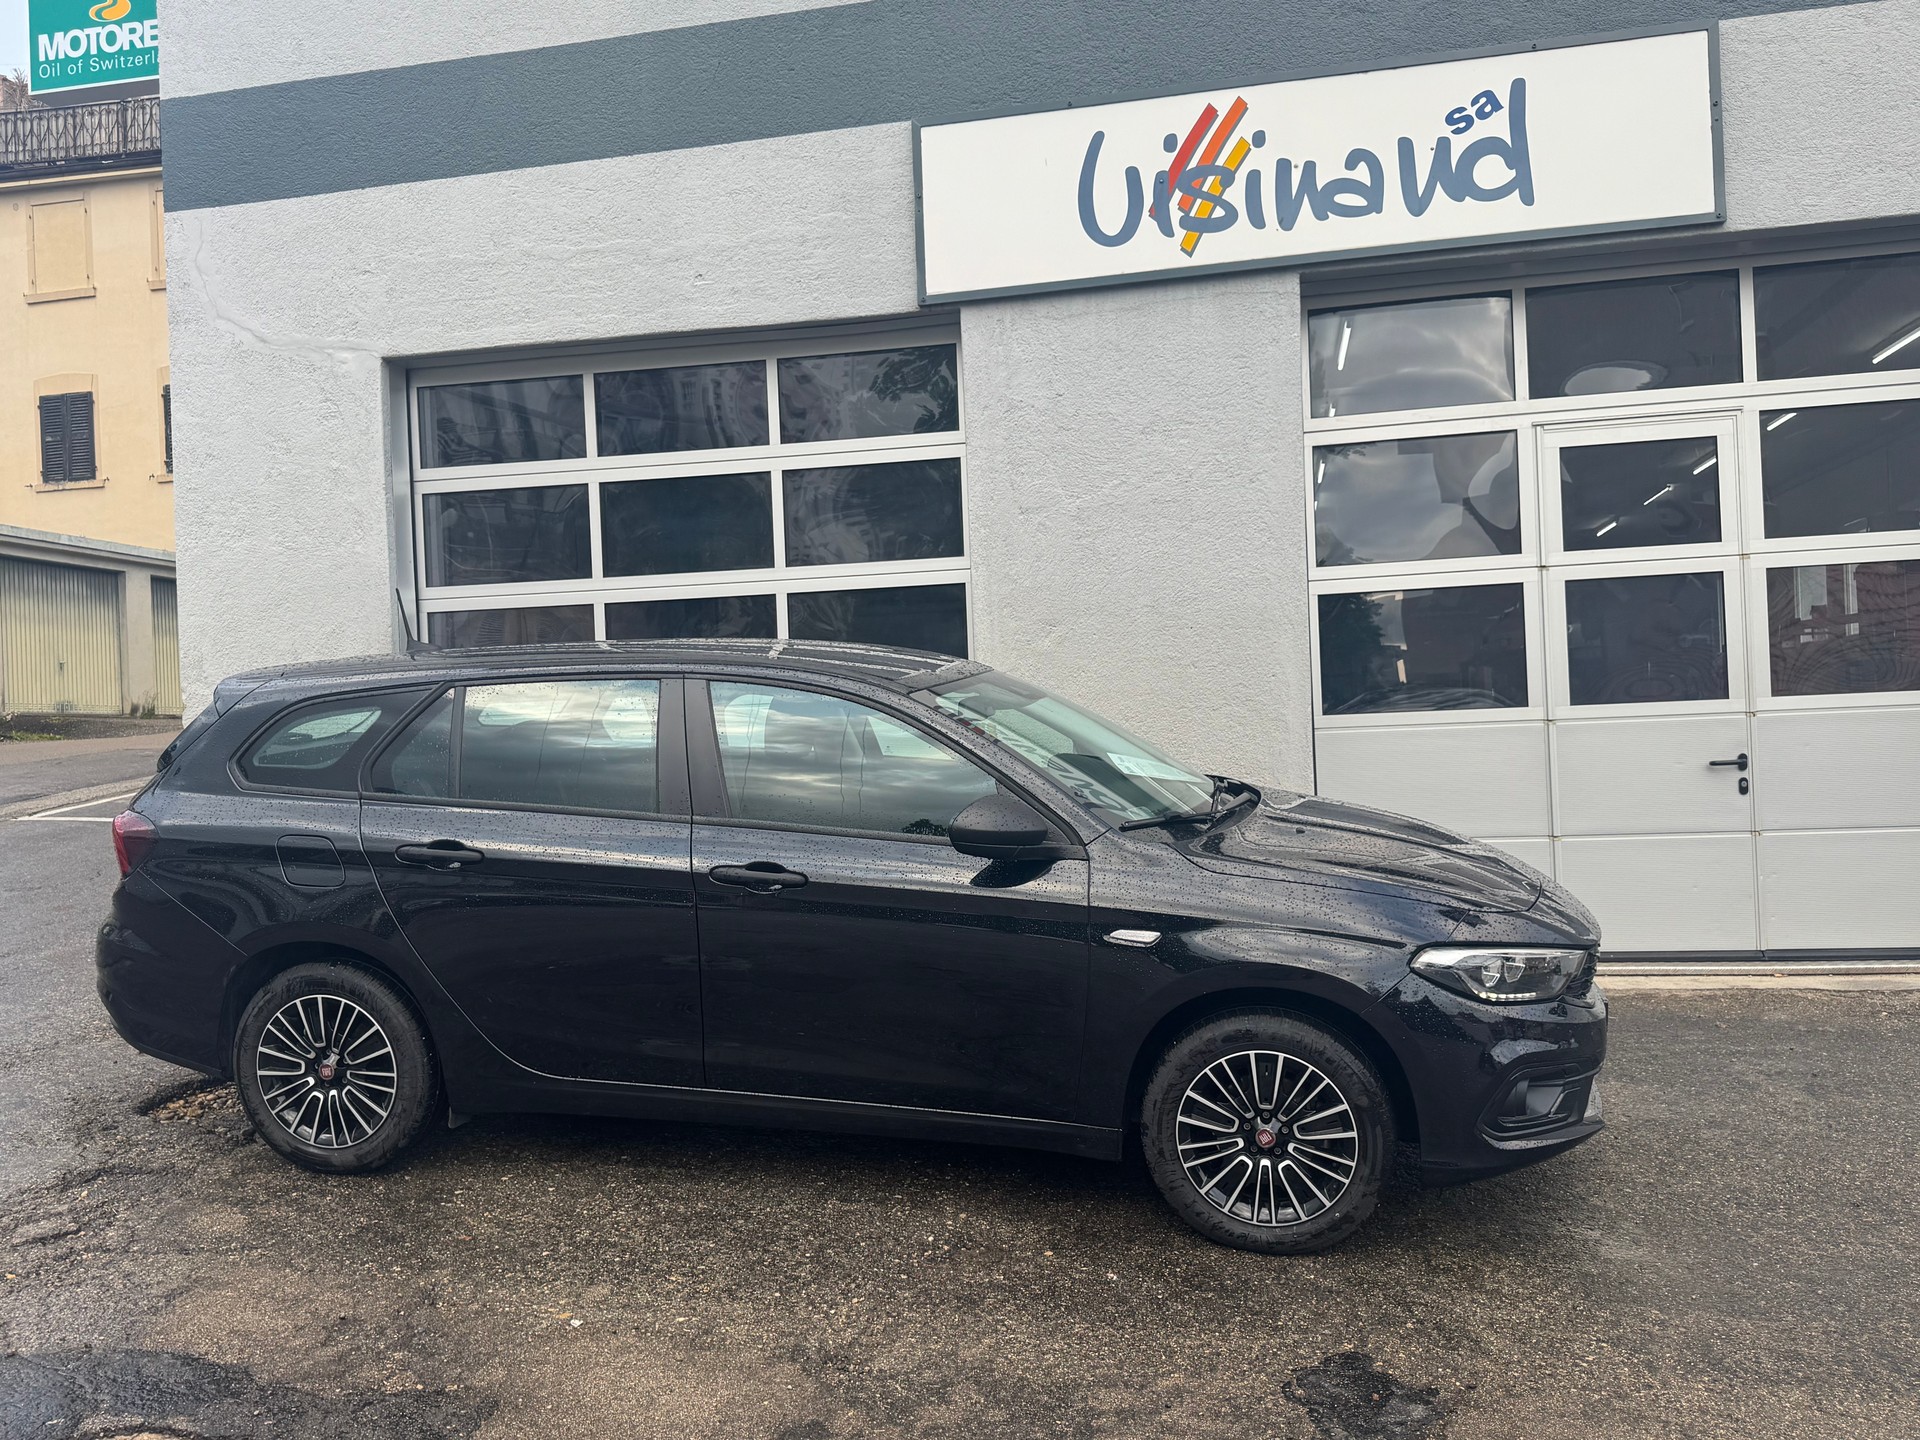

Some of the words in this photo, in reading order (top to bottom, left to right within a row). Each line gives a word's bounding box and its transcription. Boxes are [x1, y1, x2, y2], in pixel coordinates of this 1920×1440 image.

[39, 61, 61, 79] Oil
[67, 60, 83, 75] of
[90, 51, 159, 72] Switzerl
[1445, 89, 1504, 135] sa
